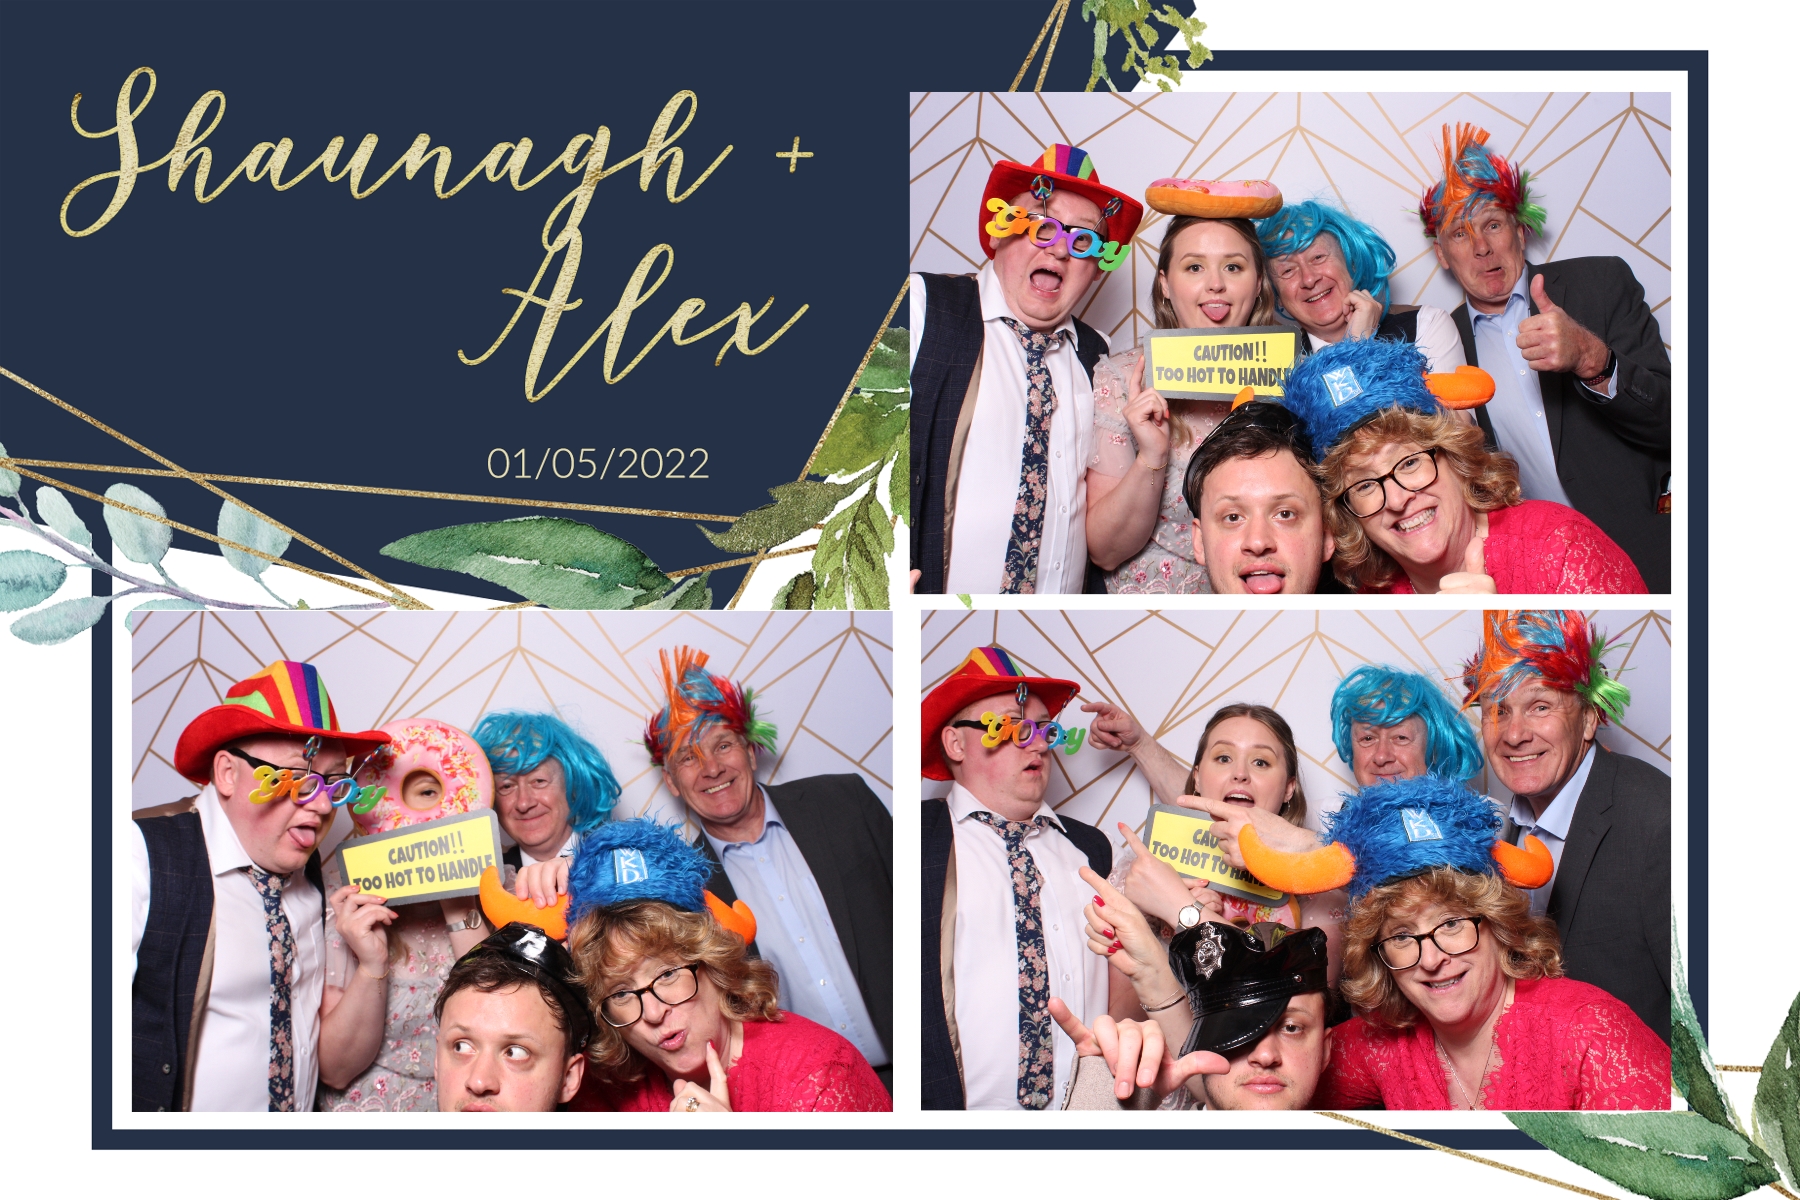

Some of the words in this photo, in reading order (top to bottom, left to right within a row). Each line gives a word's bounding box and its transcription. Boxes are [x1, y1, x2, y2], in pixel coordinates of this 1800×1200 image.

[1193, 341, 1267, 363] CAUTION!!
[1156, 366, 1184, 382] TOO
[1187, 366, 1215, 383] HOT
[1217, 367, 1236, 384] TO
[388, 830, 465, 866] CAUTION!!
[1152, 840, 1180, 860] TOO
[1180, 848, 1210, 869] HOT
[1211, 855, 1229, 875] TO
[353, 875, 383, 893] TOO
[384, 868, 413, 889] HOT
[415, 866, 436, 885] TO
